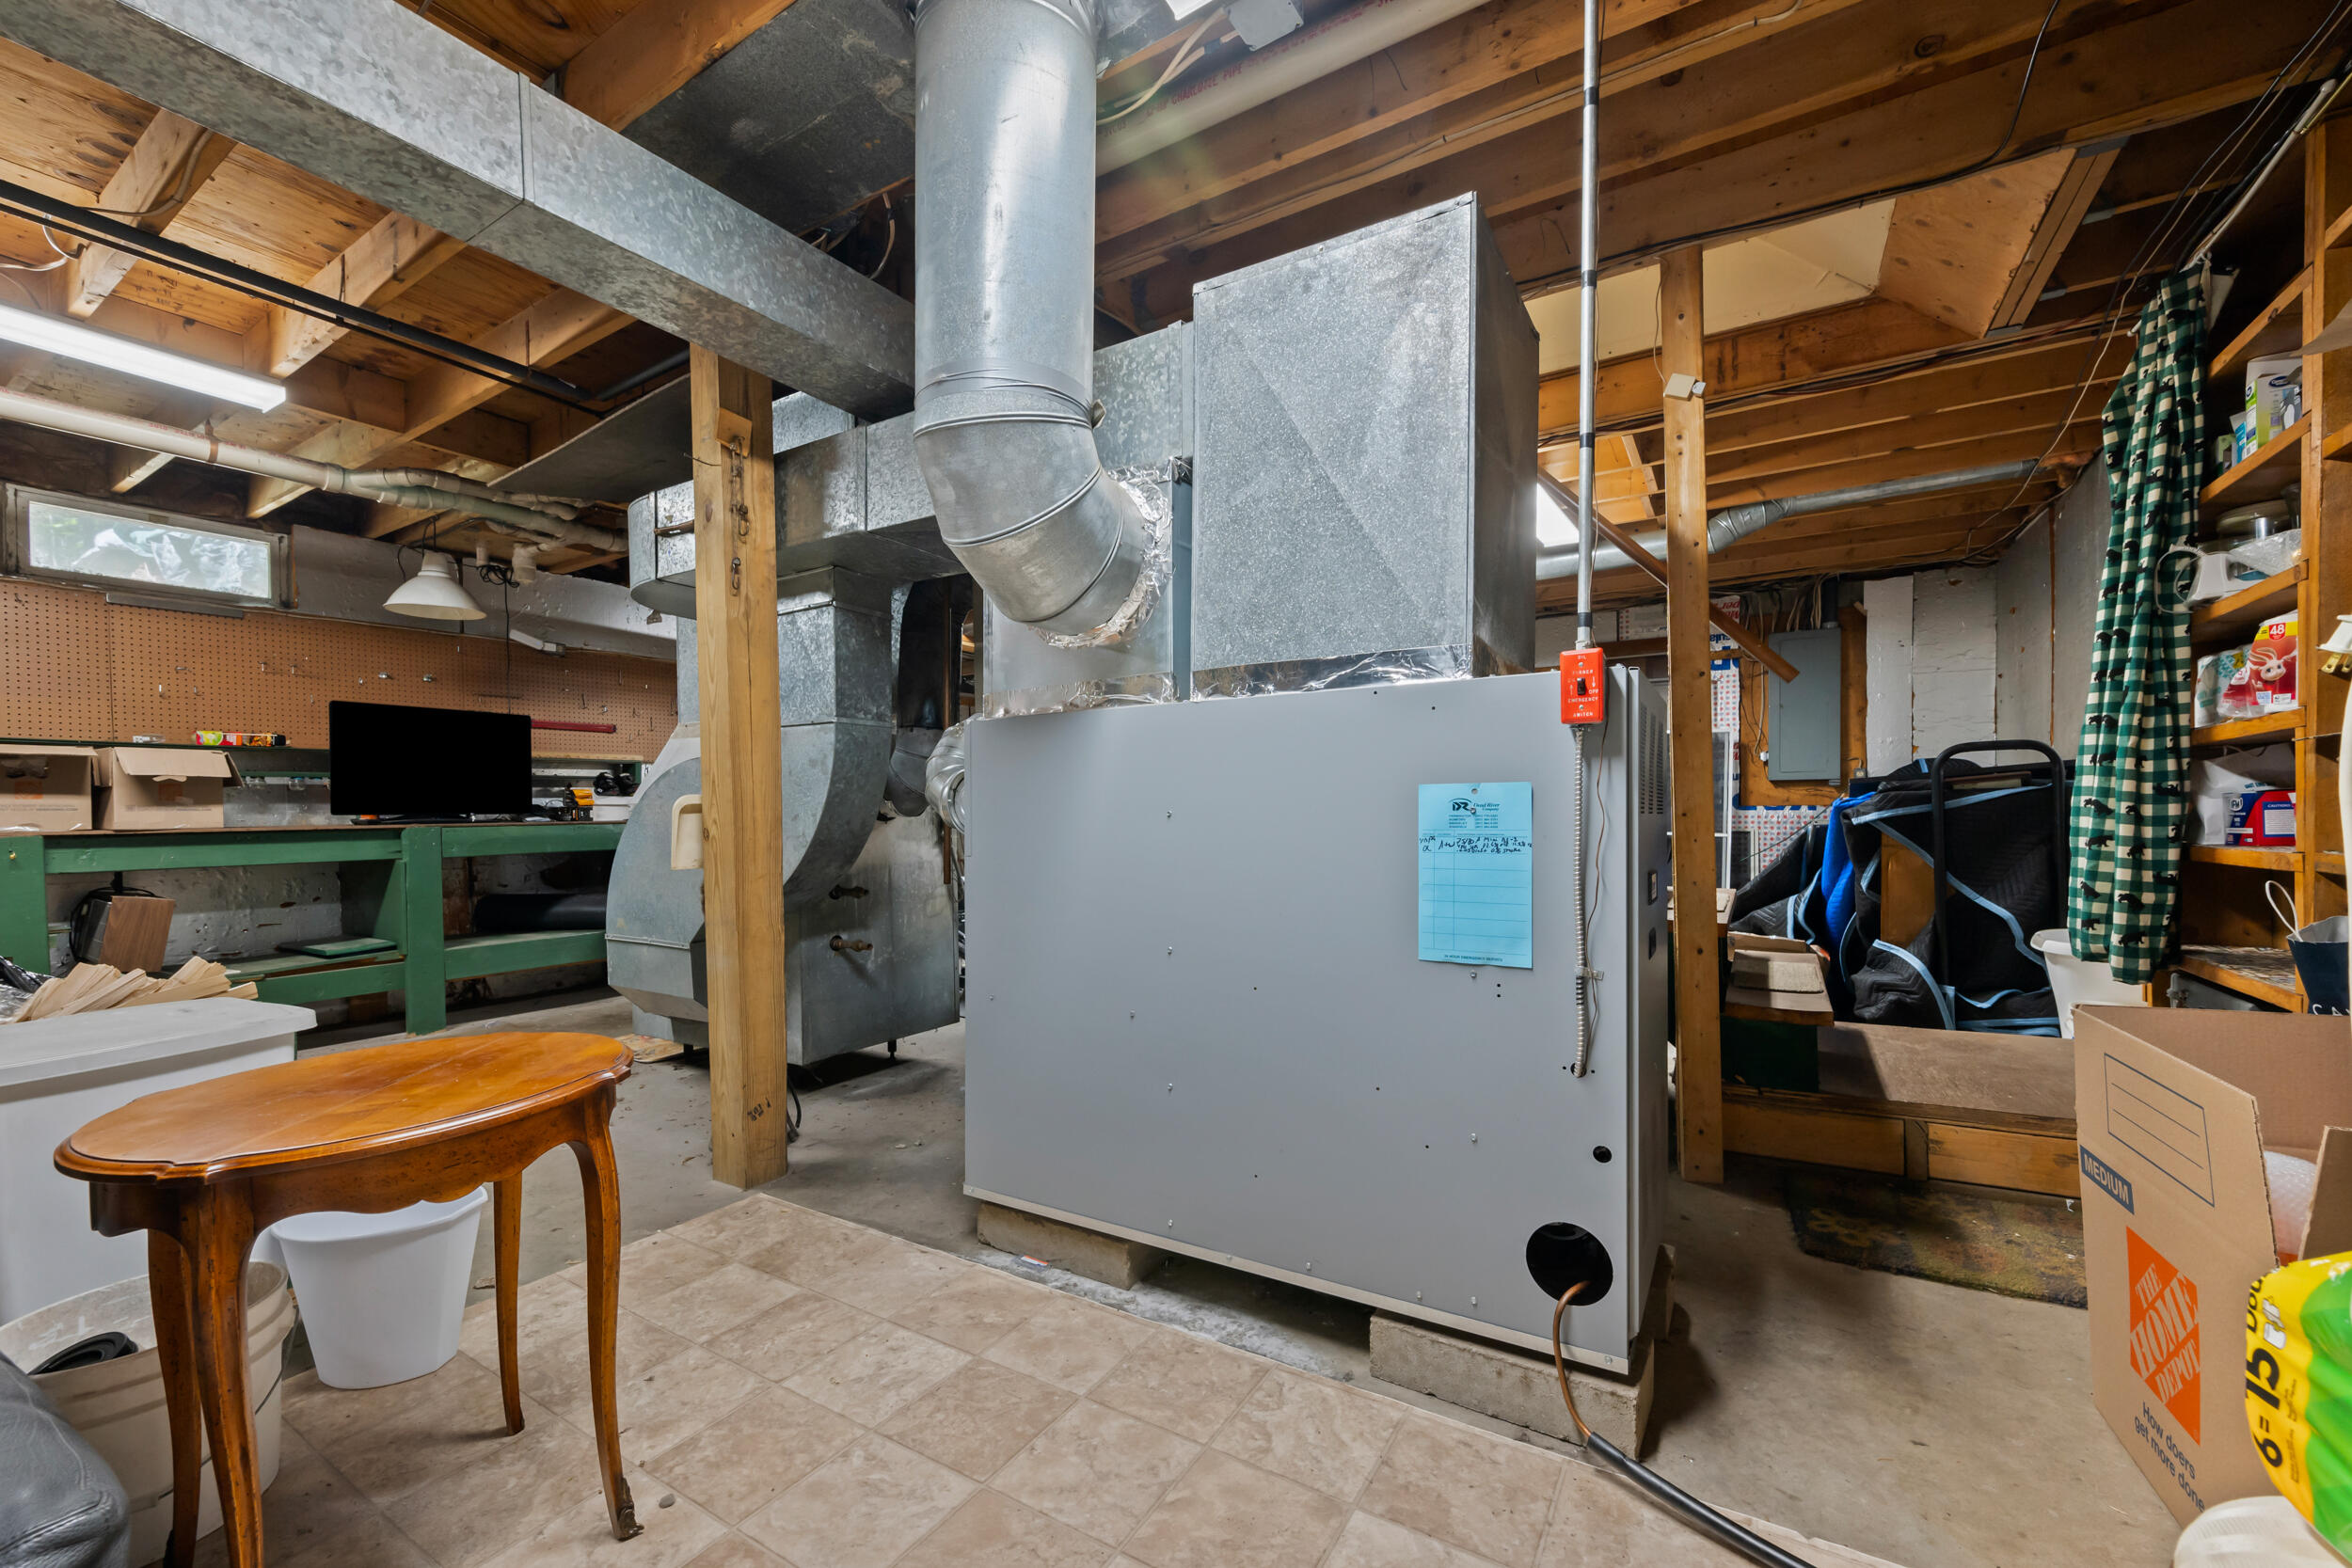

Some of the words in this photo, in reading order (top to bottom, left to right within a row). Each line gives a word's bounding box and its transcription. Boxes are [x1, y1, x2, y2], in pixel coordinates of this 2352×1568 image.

[2270, 624, 2285, 635] 48
[2084, 1153, 2130, 1205] MEDIUM
[2135, 1261, 2163, 1310] THE
[2130, 1271, 2200, 1381] HOME
[2154, 1338, 2201, 1404] DEPOT
[2246, 1348, 2280, 1411] 15
[2134, 1414, 2150, 1443] get
[2151, 1435, 2176, 1478] more
[2142, 1401, 2164, 1439] How
[2165, 1428, 2196, 1481] doers
[2251, 1433, 2283, 1468] 6
